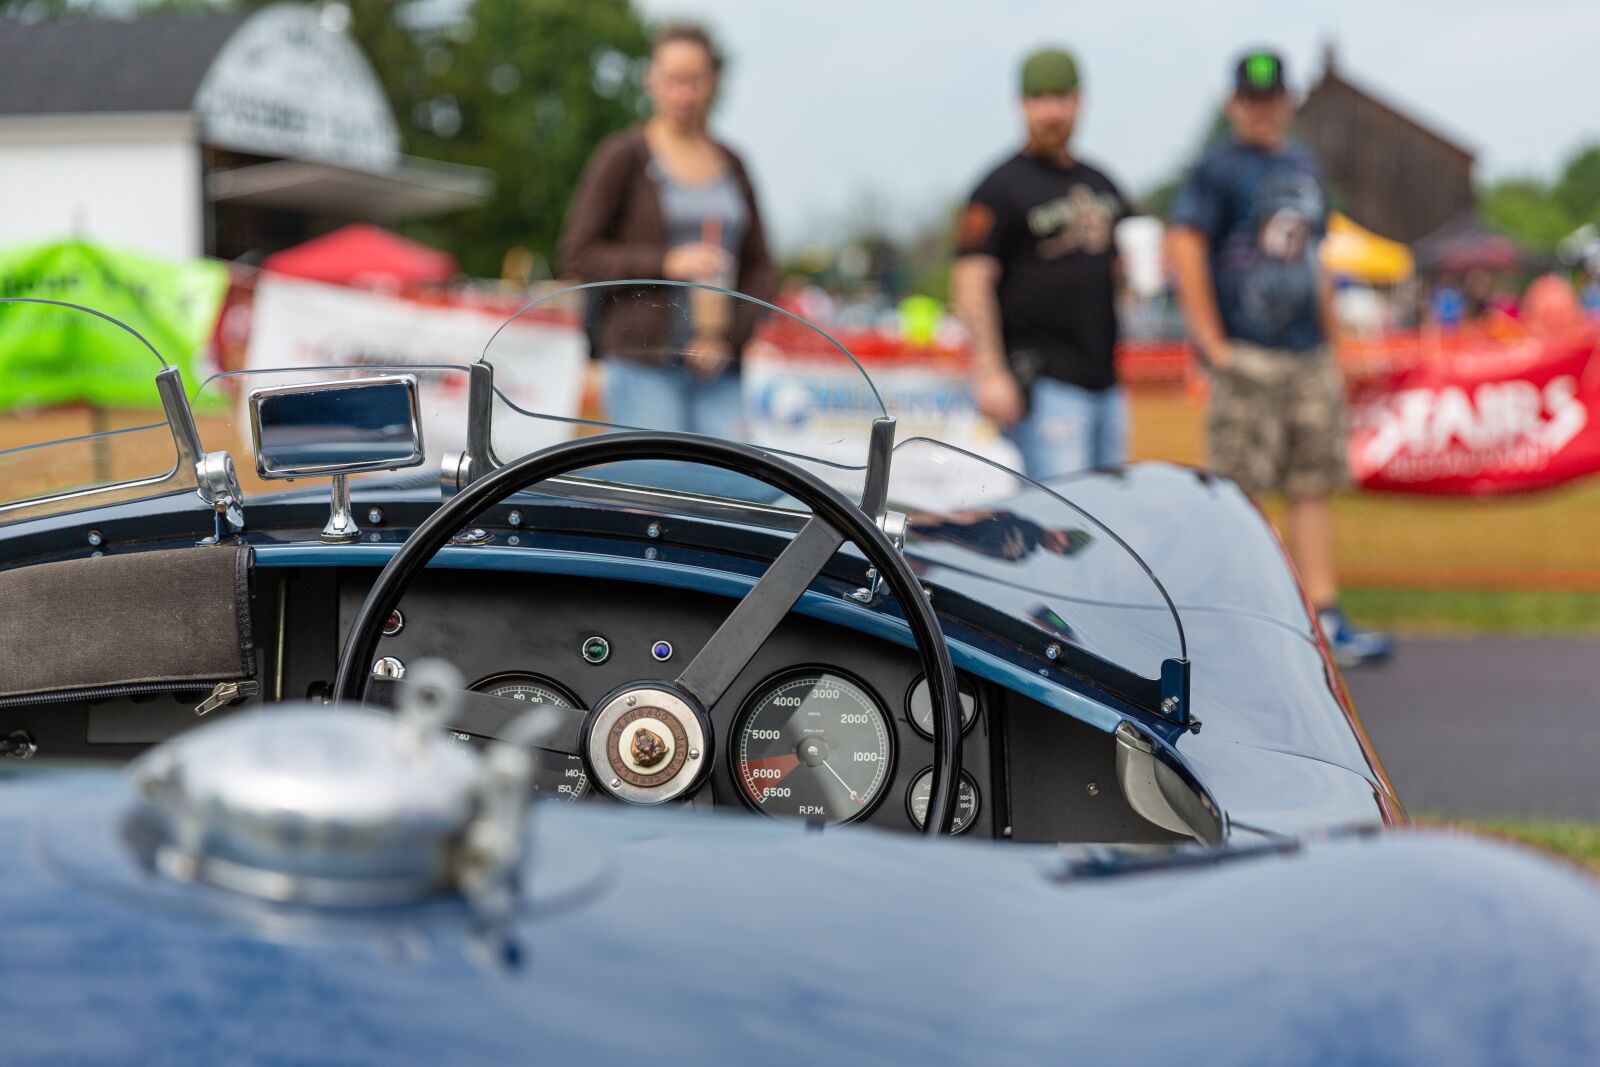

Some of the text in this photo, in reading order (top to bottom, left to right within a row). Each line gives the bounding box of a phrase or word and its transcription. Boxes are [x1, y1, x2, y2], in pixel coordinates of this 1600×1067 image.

[1351, 374, 1588, 478] STAIRS
[812, 689, 840, 699] 3000
[773, 696, 801, 707] 4000
[840, 713, 868, 724] 2000
[752, 729, 780, 740] 5000
[663, 735, 686, 777] JAGUAR
[853, 752, 877, 762] 1000
[565, 768, 579, 777] 140
[752, 768, 781, 778] 6000
[557, 784, 572, 793] 150
[762, 787, 791, 797] 6500
[799, 805, 825, 815] R.P.M.
